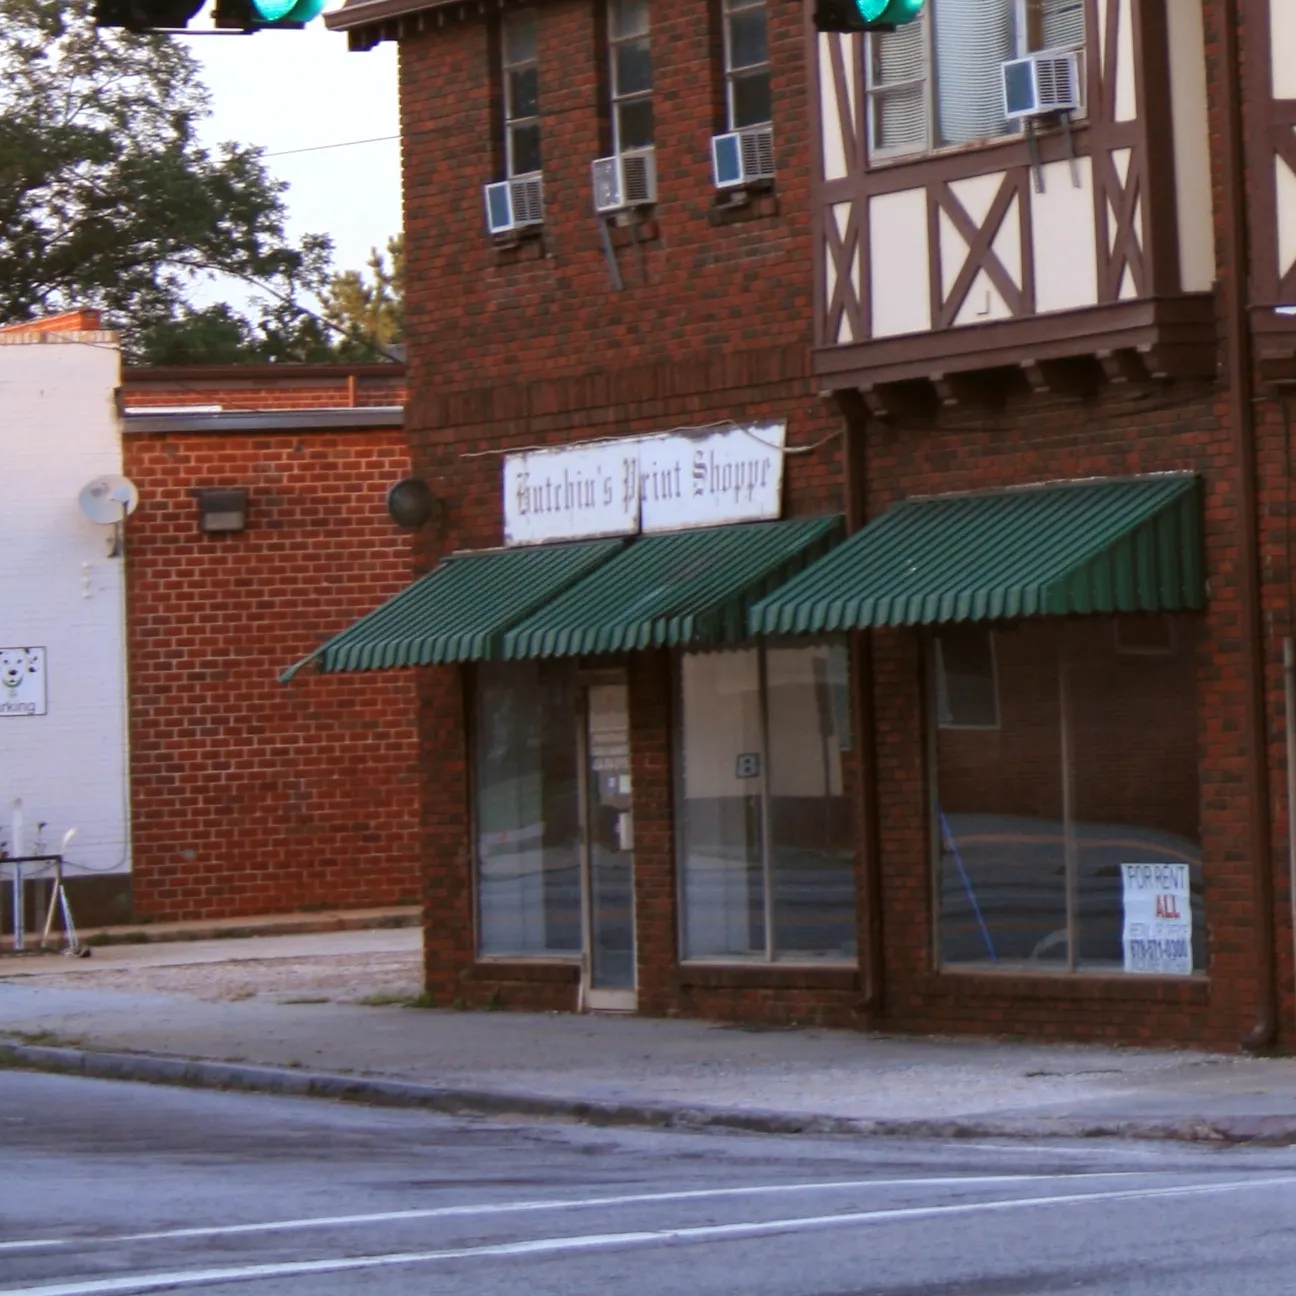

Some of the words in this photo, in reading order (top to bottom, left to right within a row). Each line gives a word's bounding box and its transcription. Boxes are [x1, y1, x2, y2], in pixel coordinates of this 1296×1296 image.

[623, 457, 681, 514] Print
[693, 450, 772, 504] Shoppe
[1127, 865, 1153, 889] FOR
[1154, 865, 1186, 890] RENT
[1156, 894, 1181, 919] ALL
